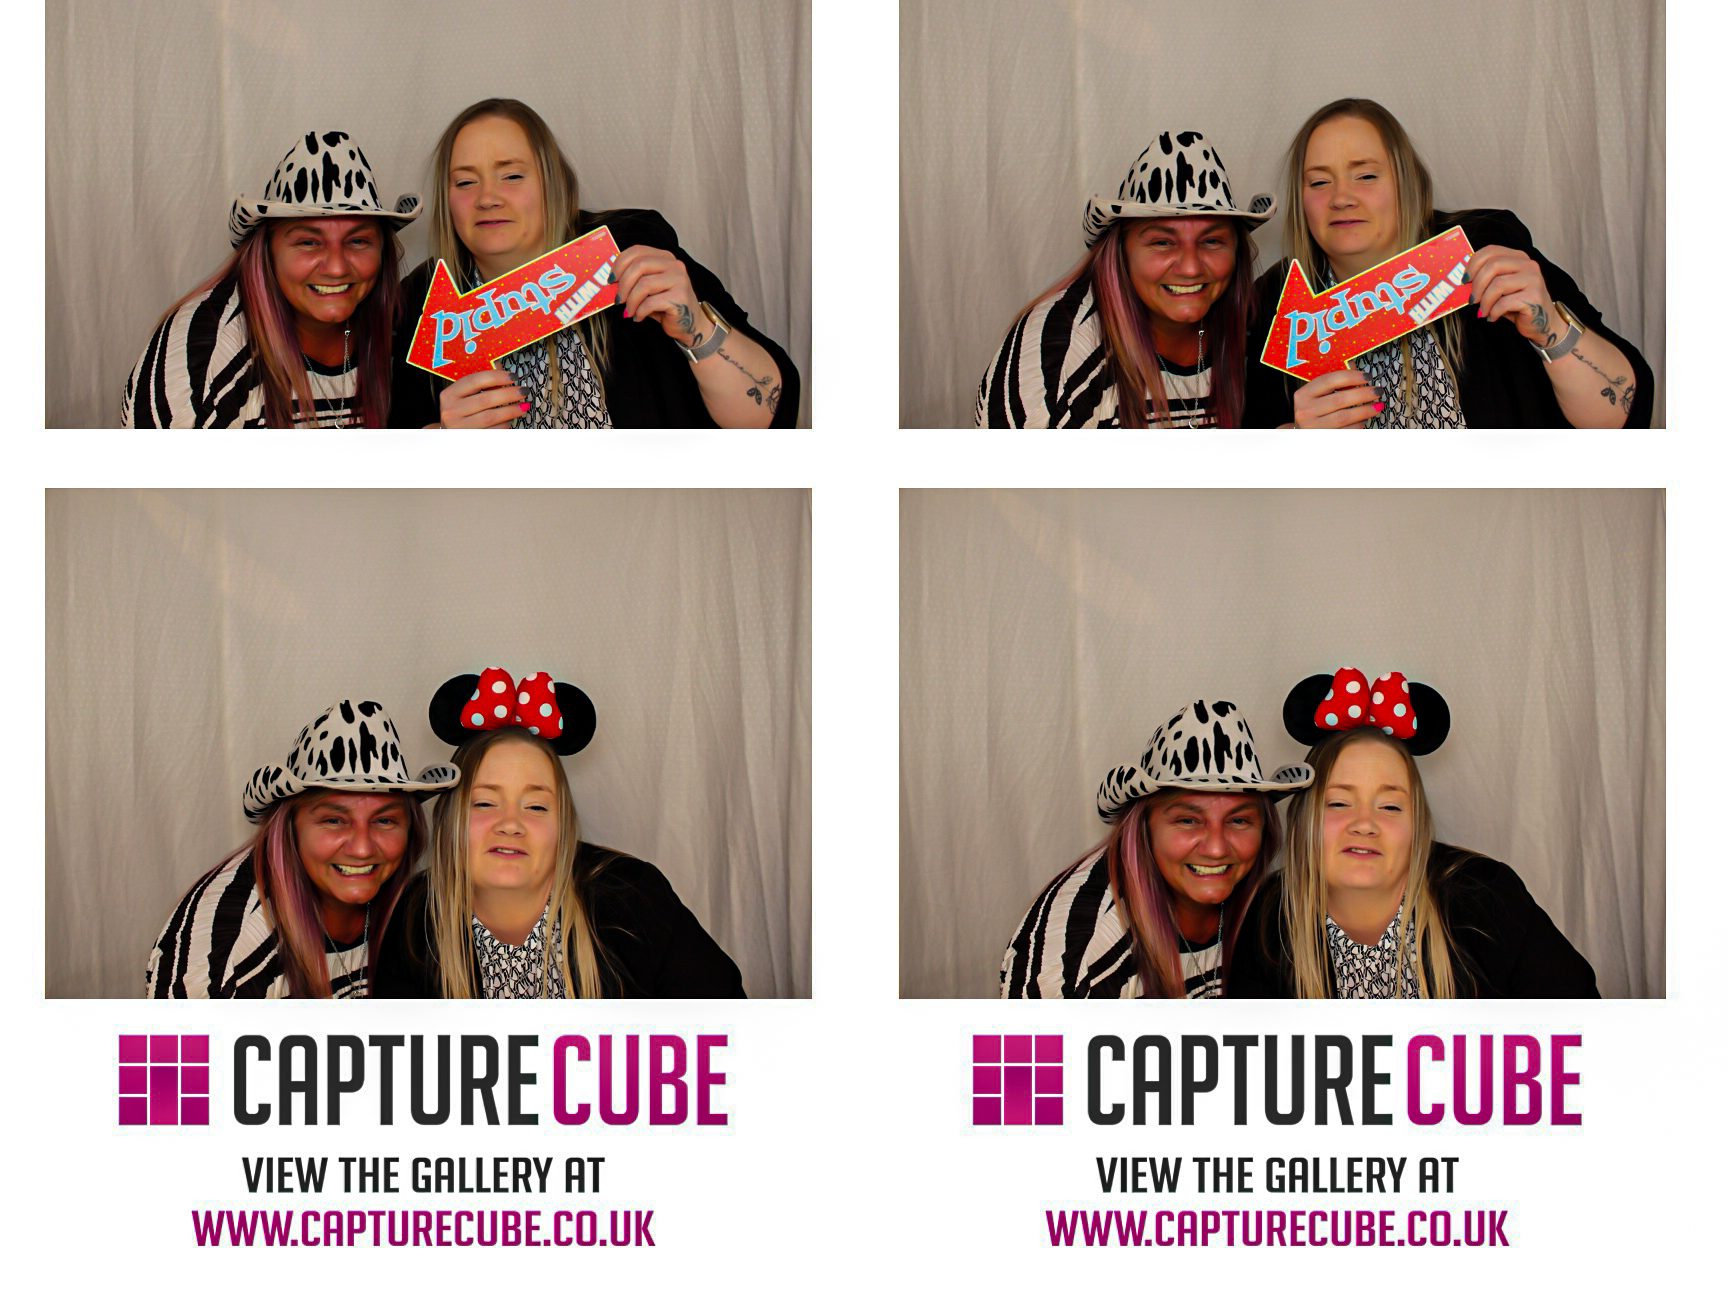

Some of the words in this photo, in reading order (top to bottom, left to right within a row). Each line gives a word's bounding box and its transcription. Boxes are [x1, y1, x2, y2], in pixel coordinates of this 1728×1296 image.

[430, 264, 577, 369] stupid
[554, 280, 601, 325] WITH
[1284, 264, 1431, 369] stupid
[1408, 280, 1455, 325] WITH
